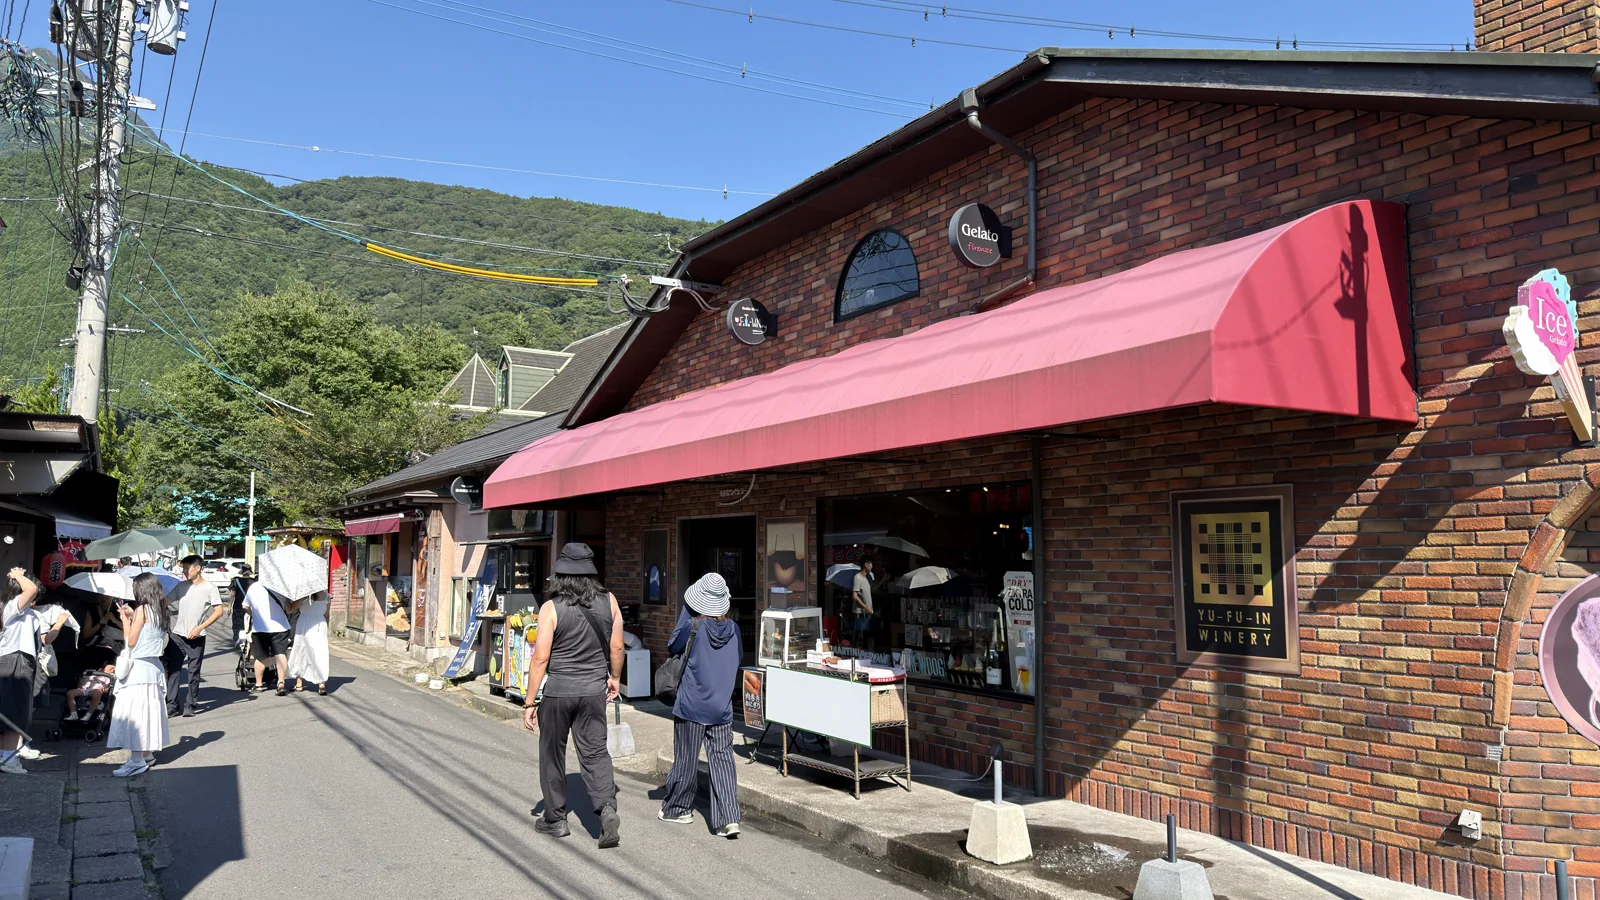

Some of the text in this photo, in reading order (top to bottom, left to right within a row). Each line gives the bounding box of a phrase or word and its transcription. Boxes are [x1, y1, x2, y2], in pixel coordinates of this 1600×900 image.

[961, 223, 999, 243] Gelato
[967, 241, 993, 255] firenze
[1535, 297, 1567, 337] Ice
[1008, 598, 1034, 612] COLD
[1197, 608, 1271, 626] YU-FU-IN
[1199, 628, 1271, 647] WINERY
